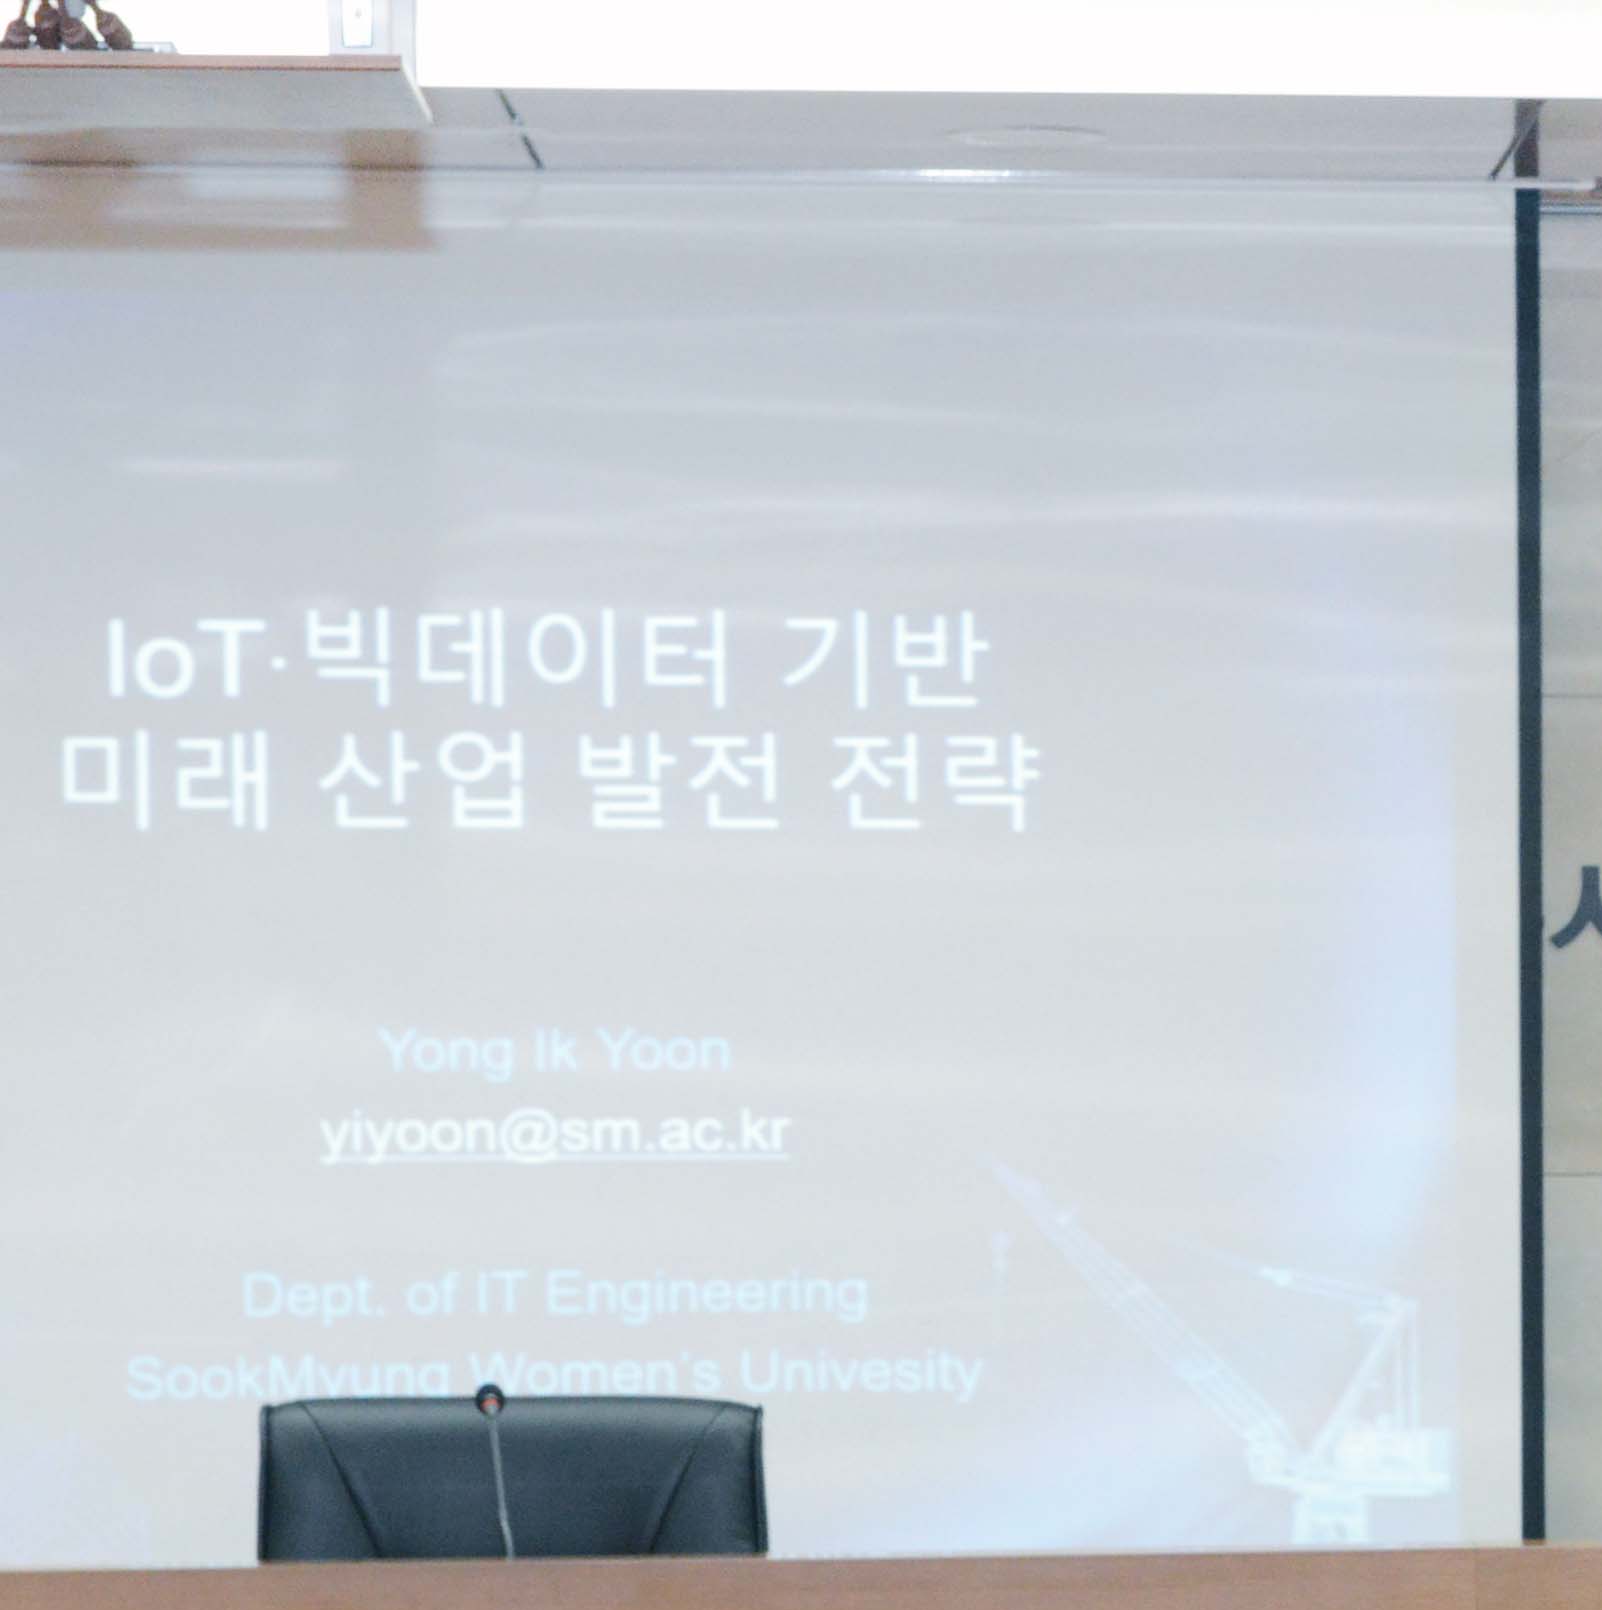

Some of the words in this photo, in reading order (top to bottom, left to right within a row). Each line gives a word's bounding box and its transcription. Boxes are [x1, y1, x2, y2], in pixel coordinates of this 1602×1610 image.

[781, 607, 990, 709] 기반
[59, 730, 270, 832] 미래
[317, 730, 526, 832] 산업
[576, 730, 782, 832] 발전
[829, 730, 1042, 833] 전략
[377, 1027, 515, 1083] Yong
[533, 1027, 578, 1073] Ik
[597, 1027, 732, 1073] Yoon
[319, 1108, 793, 1164] yiyoon@sm.ac.kr
[241, 1271, 385, 1326] Dept.
[406, 1269, 460, 1317] of
[476, 1269, 530, 1315] IT
[545, 1267, 870, 1325] Engineering
[126, 1354, 451, 1401] SookMyung
[466, 1350, 722, 1398] Women's
[738, 1347, 985, 1402] Univesity
